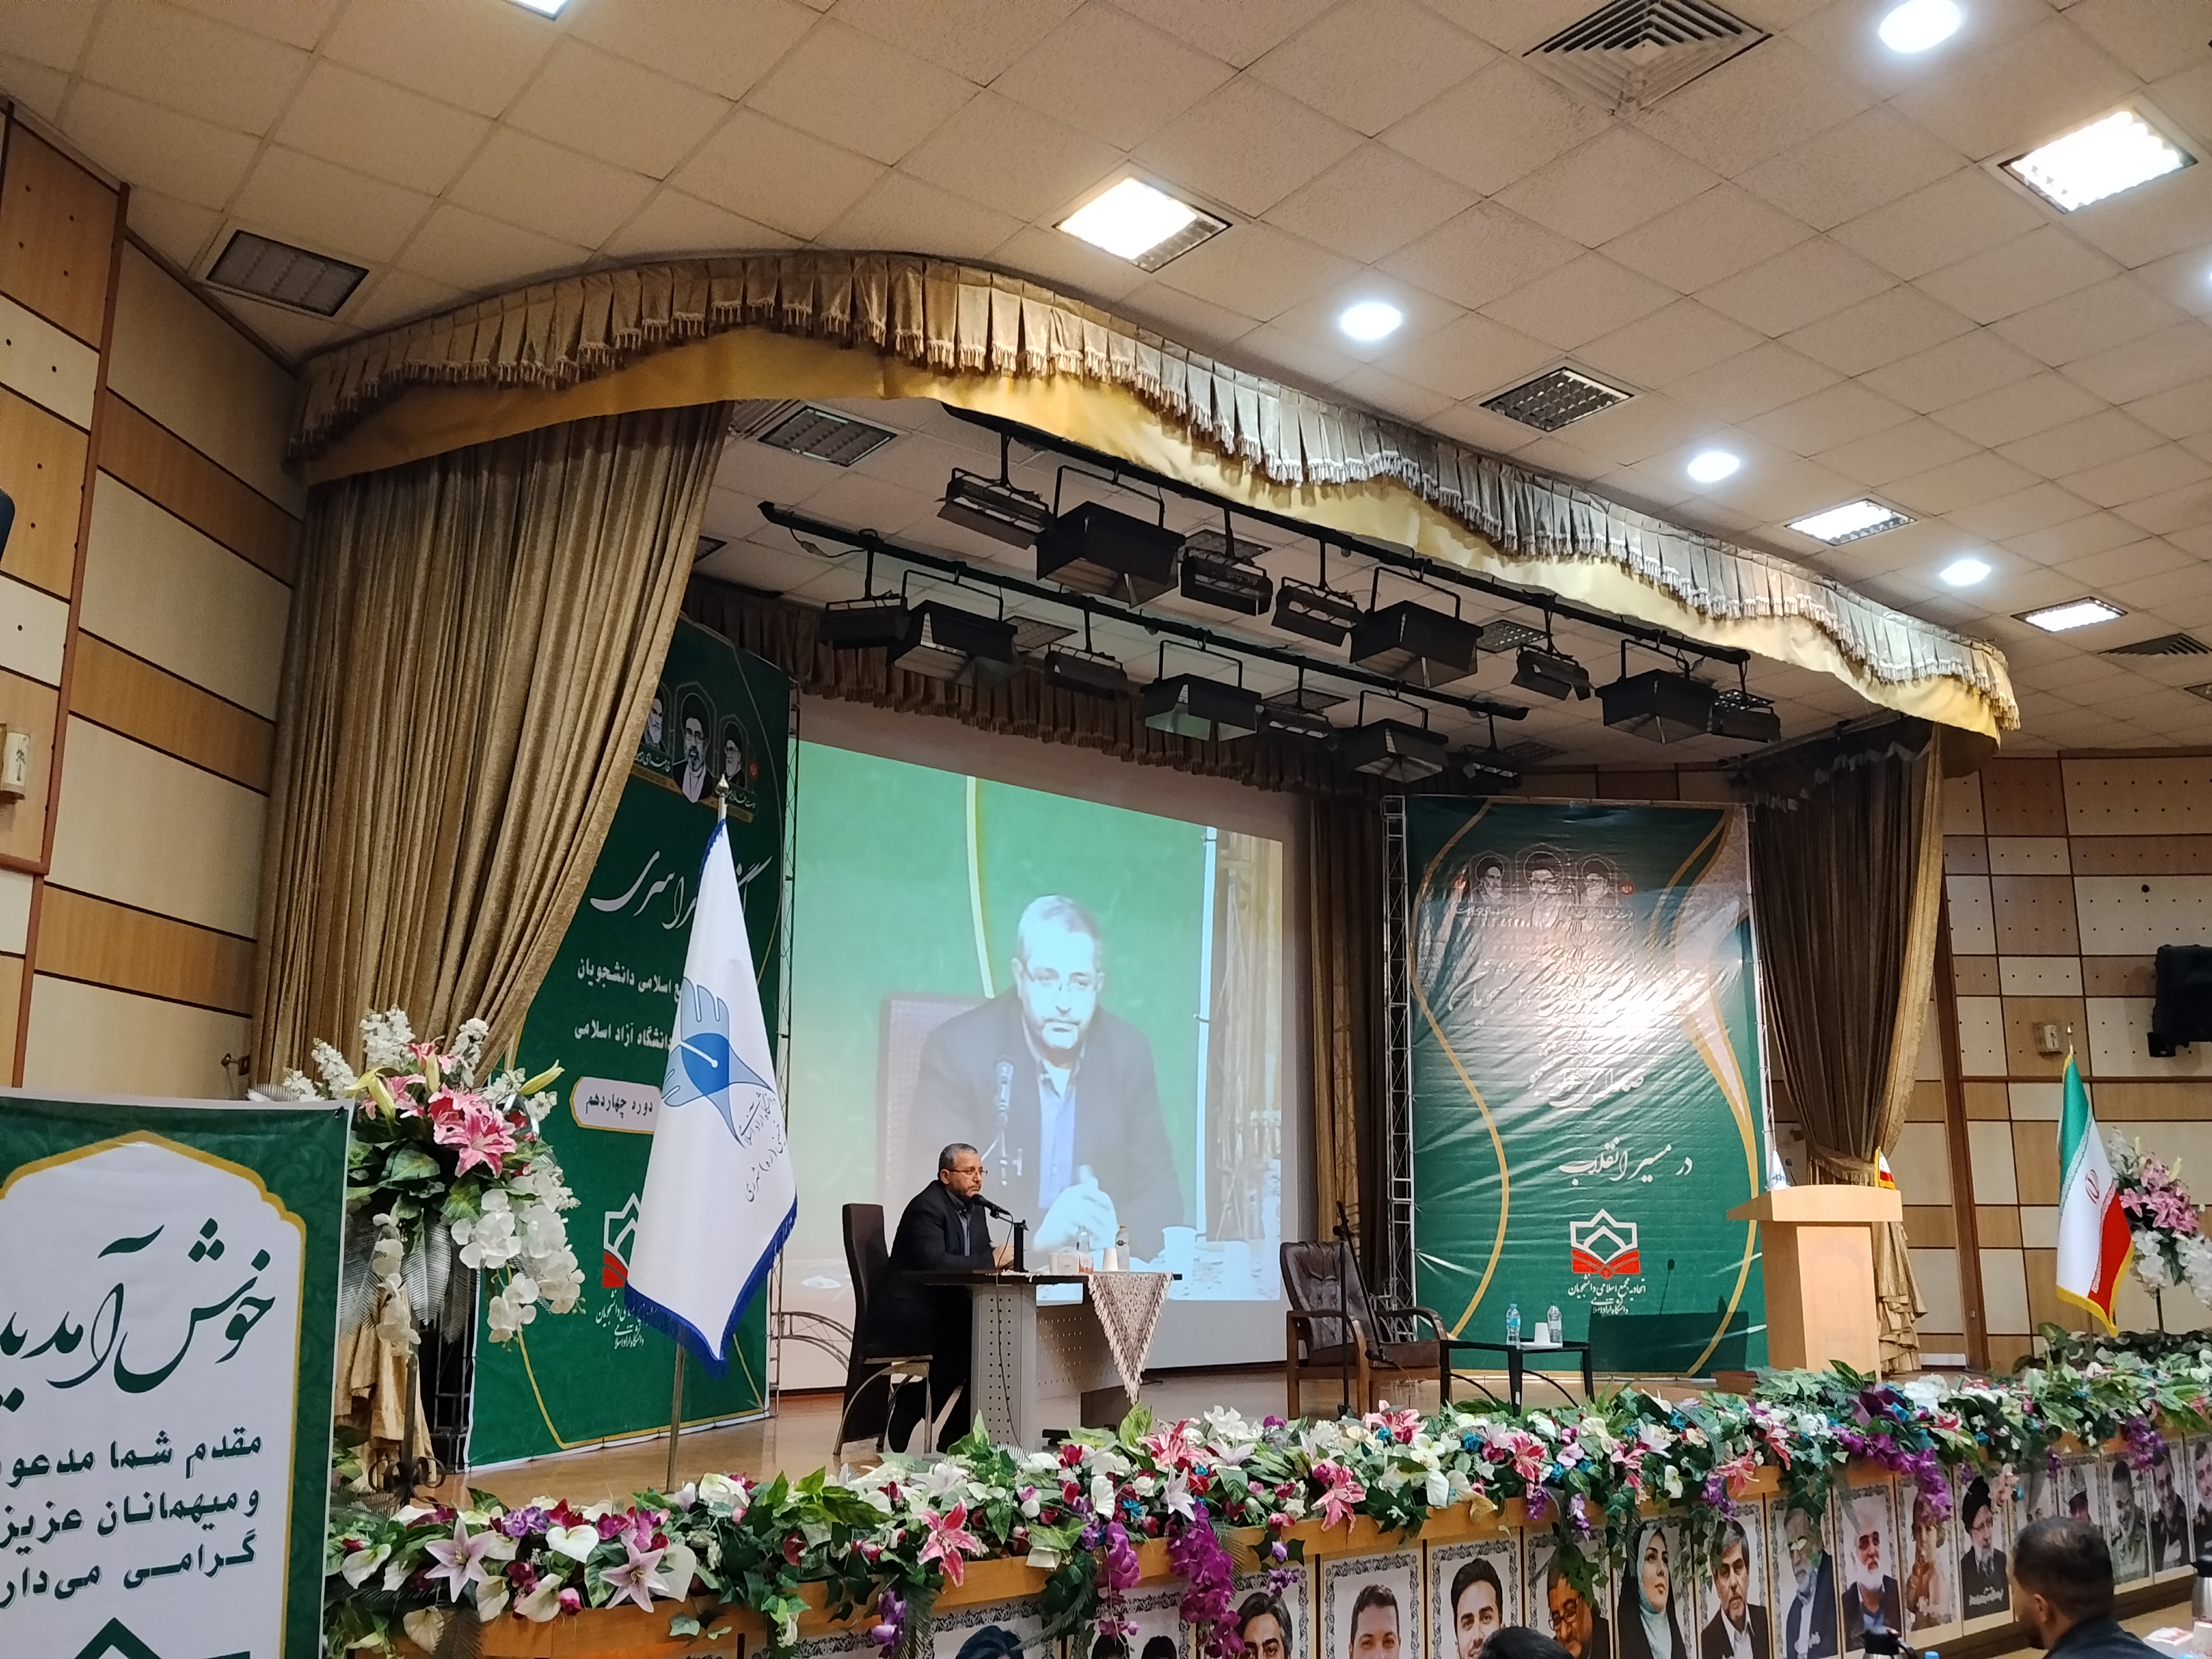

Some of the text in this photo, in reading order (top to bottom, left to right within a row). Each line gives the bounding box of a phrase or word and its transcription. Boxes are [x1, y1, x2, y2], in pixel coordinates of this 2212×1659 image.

[577, 958, 635, 989] دانشجویان
[638, 974, 671, 994] اسلامی
[574, 1019, 611, 1040] اسلامی
[615, 1022, 634, 1048] آزاد
[585, 1092, 653, 1120] دوره چهاردهم
[1559, 1136, 1692, 1186] در مسیر انقلاب
[1568, 1273, 1596, 1299] دانشجویان
[114, 1217, 276, 1394] خوش
[5, 1426, 263, 1489] مقدم شما مدعو
[0, 1500, 83, 1556] عزیز
[123, 1528, 257, 1590] گرامی
